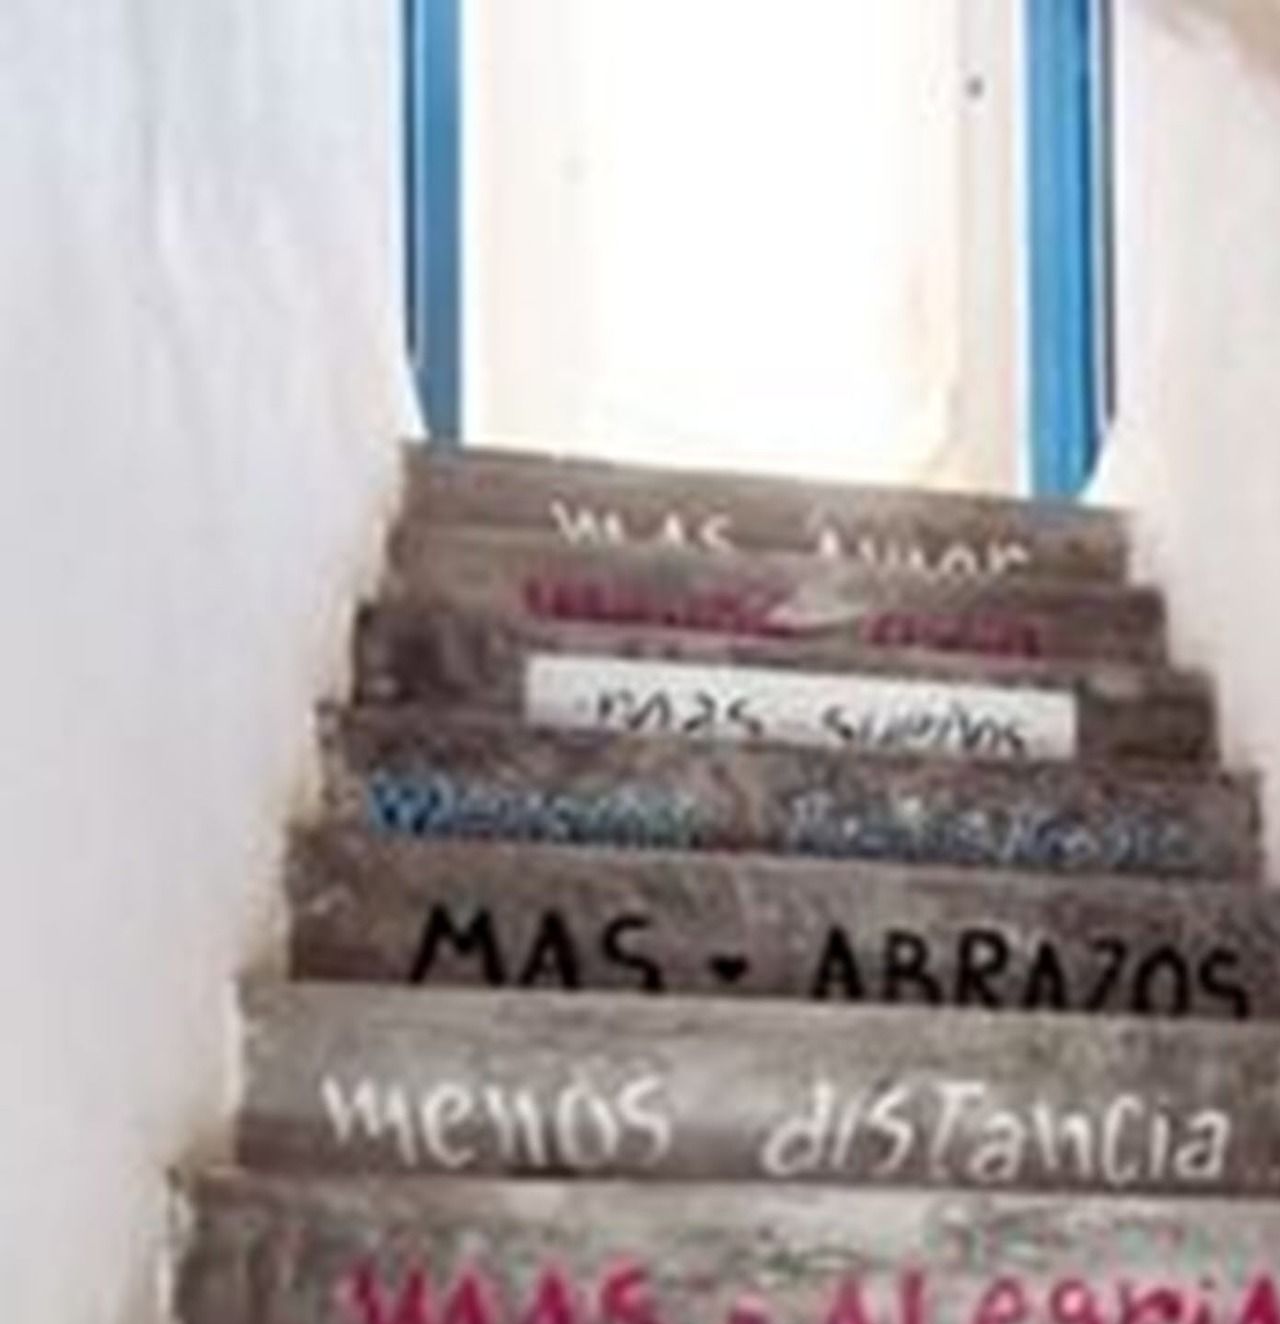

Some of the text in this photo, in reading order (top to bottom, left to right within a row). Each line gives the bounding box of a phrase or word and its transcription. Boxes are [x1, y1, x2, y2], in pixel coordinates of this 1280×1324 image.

[408, 902, 1250, 1020] MAS ABRAZOS
[324, 1074, 674, 1172] menos
